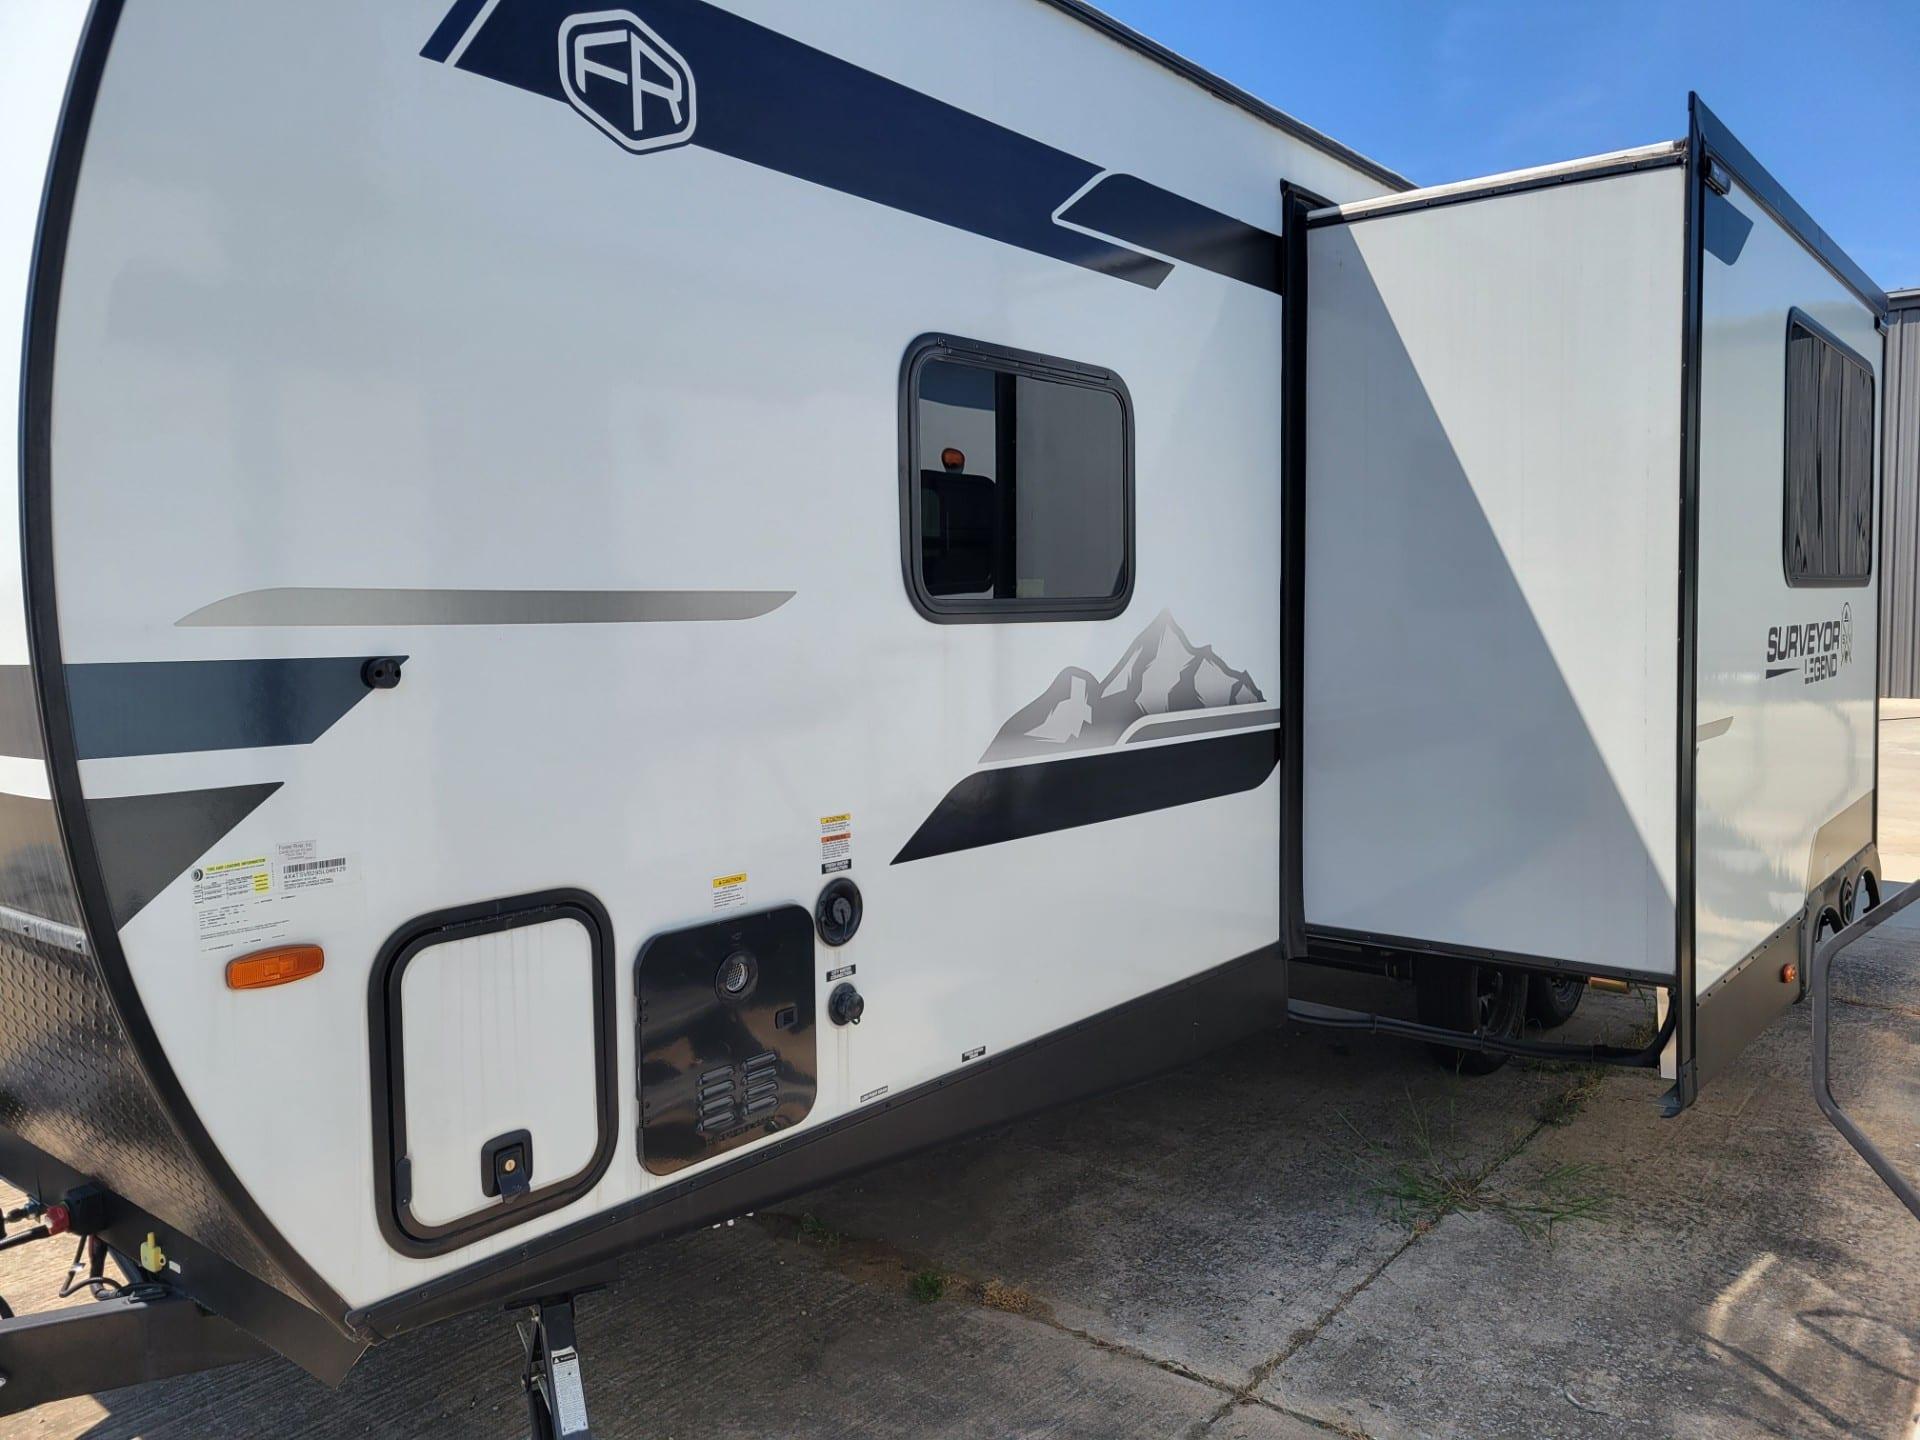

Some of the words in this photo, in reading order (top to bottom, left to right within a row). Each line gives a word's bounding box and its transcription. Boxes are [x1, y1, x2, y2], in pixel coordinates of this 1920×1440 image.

[574, 29, 682, 131] FR
[1767, 620, 1841, 663] SURVEYOR
[1804, 653, 1838, 685] LEGEND
